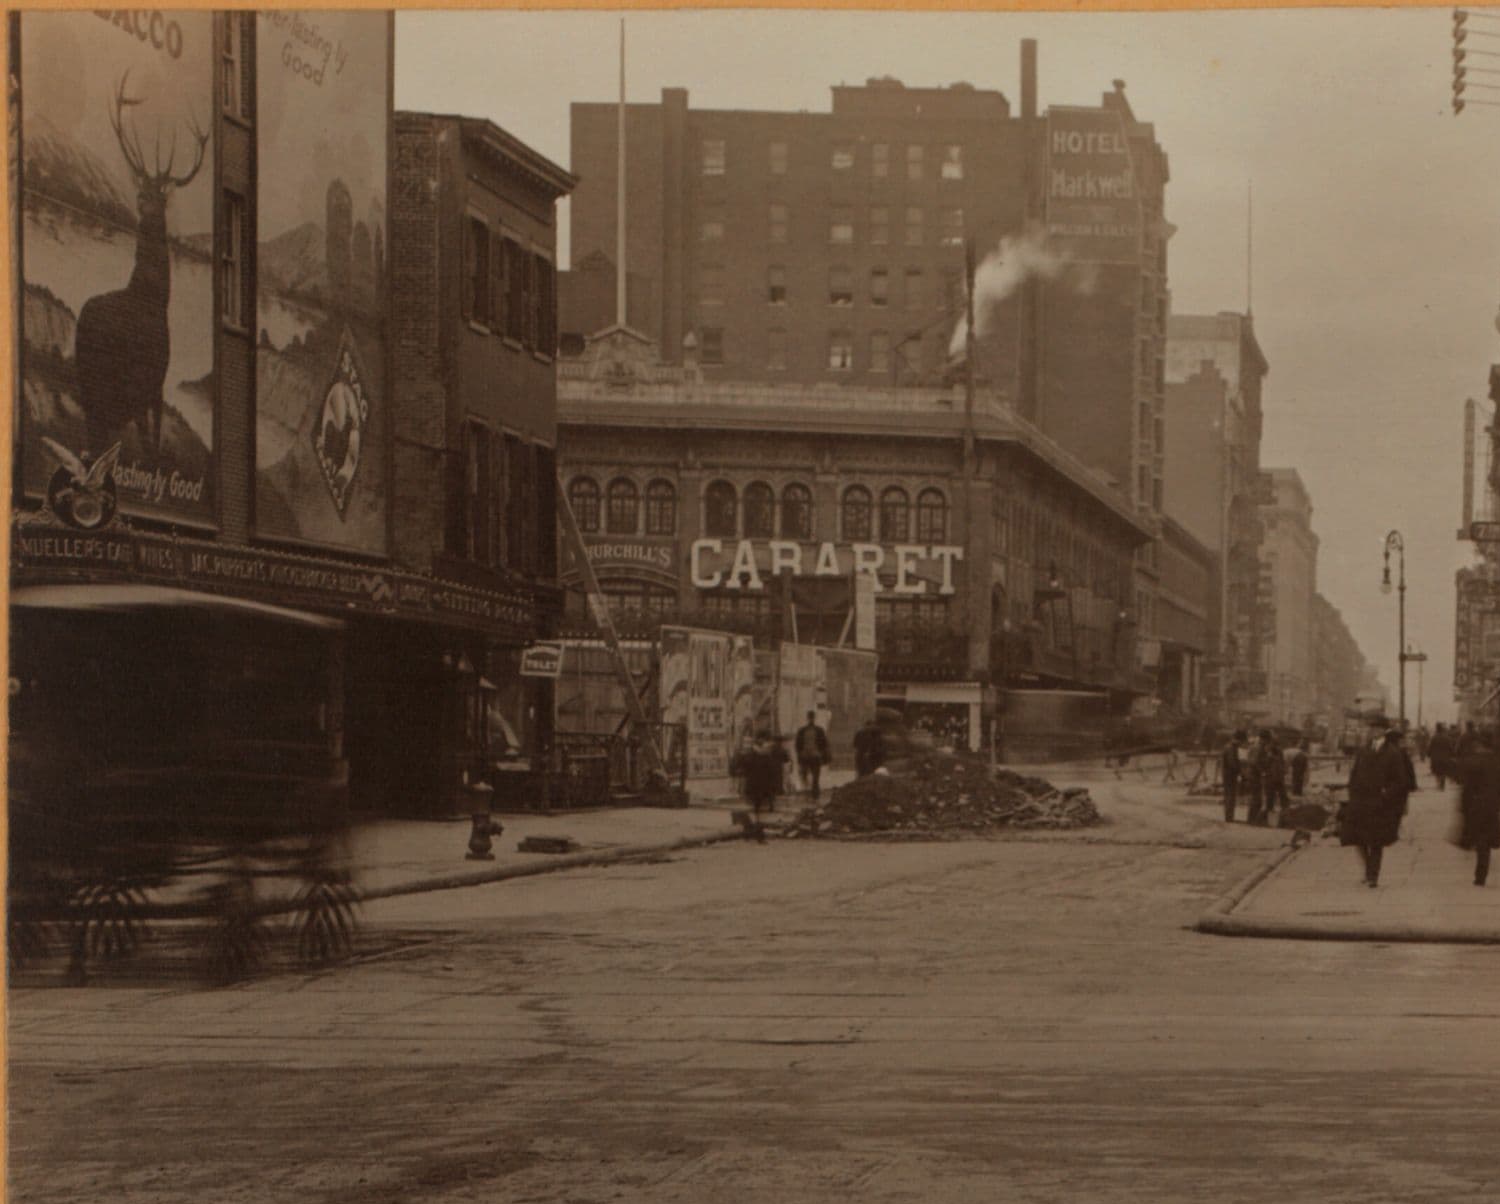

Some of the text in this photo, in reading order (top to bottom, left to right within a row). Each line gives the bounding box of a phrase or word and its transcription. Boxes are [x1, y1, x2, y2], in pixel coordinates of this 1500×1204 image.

[281, 42, 326, 87] Good
[1052, 130, 1125, 154] HOTEL
[170, 470, 204, 501] Good
[691, 538, 964, 595] CABARET
